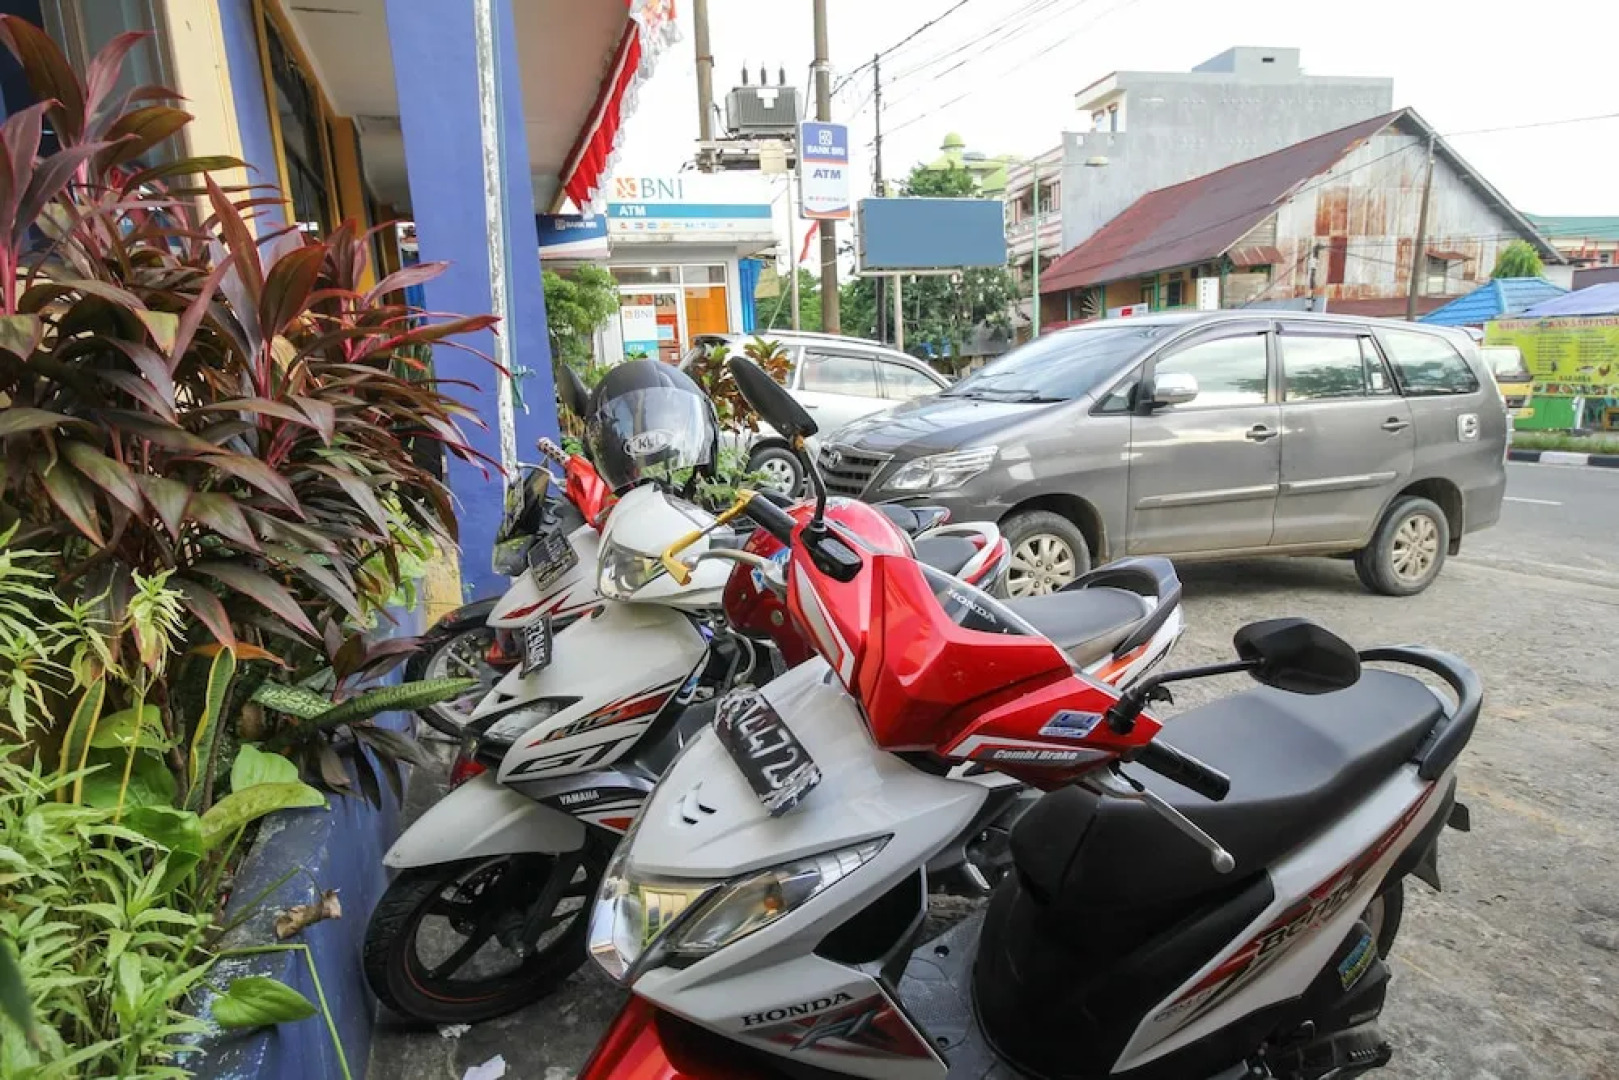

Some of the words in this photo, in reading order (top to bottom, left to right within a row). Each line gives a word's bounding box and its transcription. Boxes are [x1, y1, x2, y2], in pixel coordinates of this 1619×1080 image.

[813, 169, 841, 179] ATM
[640, 178, 683, 199] BNI
[619, 205, 646, 217] ATM
[948, 589, 998, 625] HONDA
[993, 750, 1037, 761] Combi
[1038, 751, 1079, 761] Brake
[559, 789, 600, 806] YAMAHA
[740, 992, 854, 1026] HONDA
